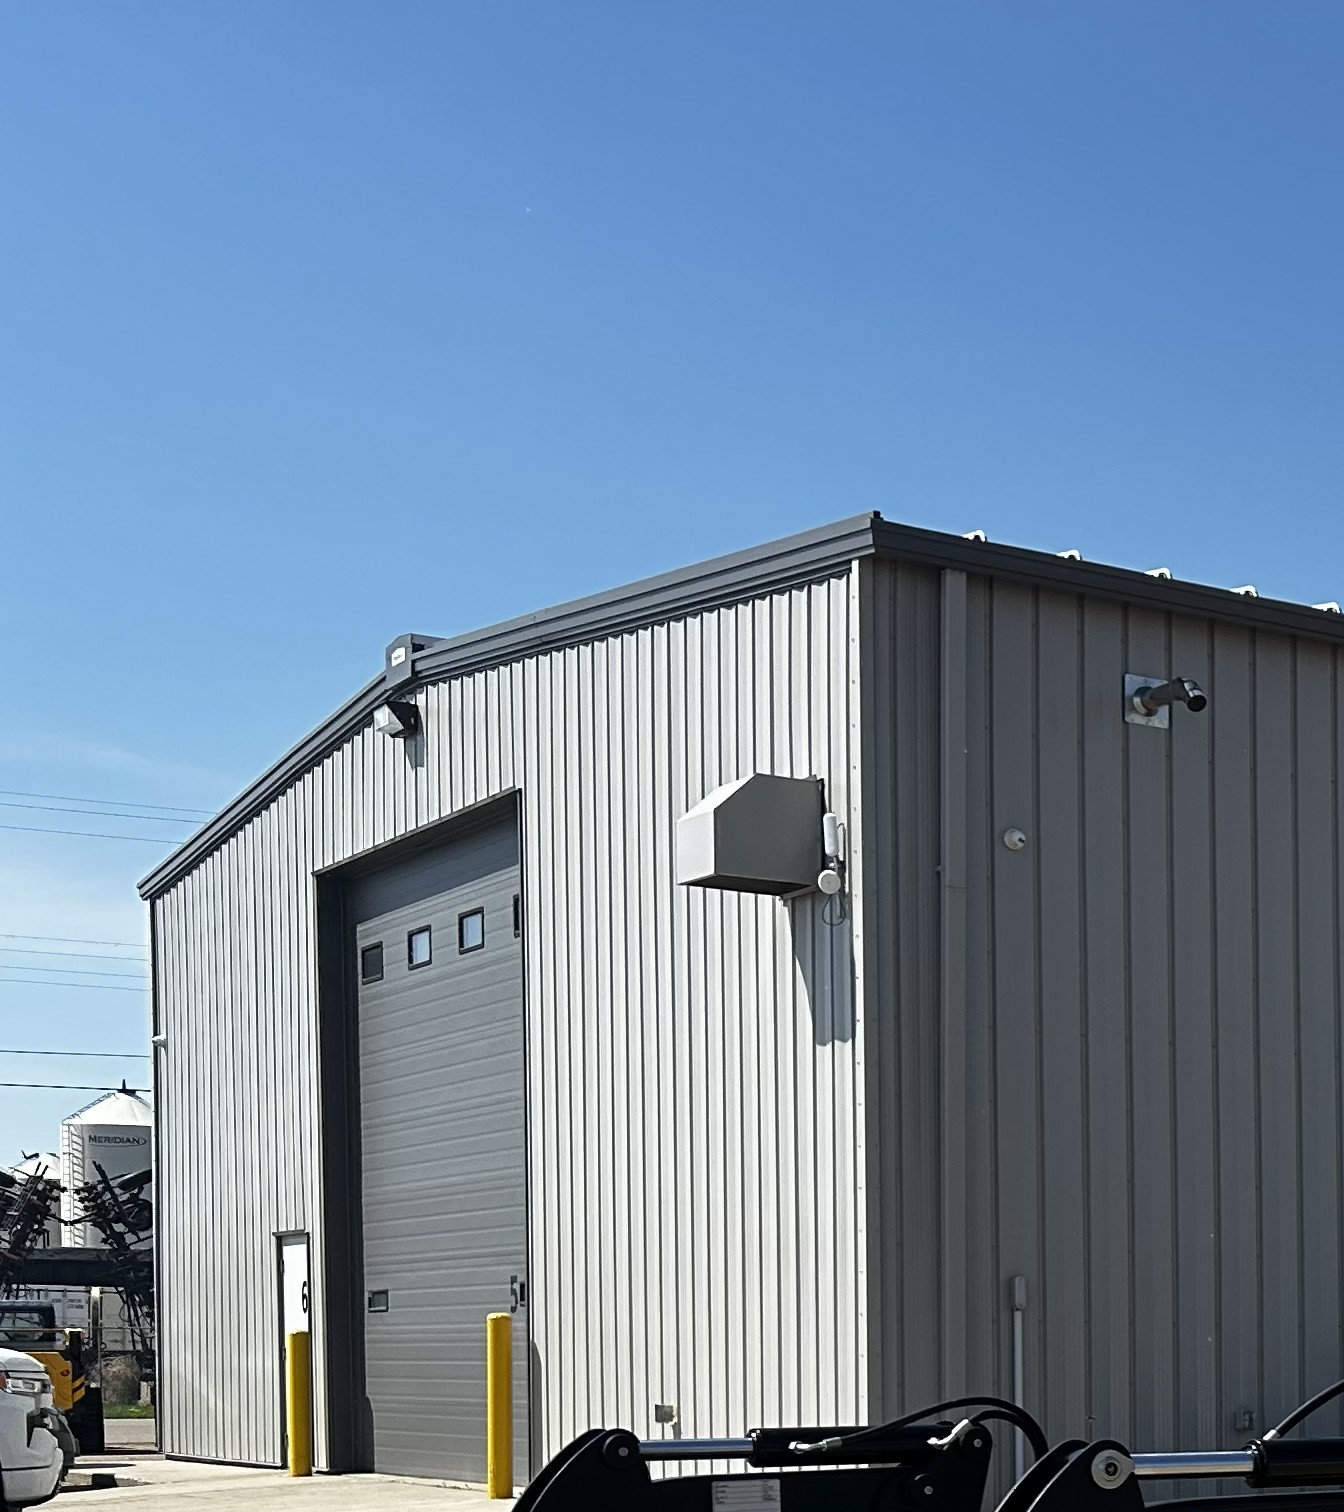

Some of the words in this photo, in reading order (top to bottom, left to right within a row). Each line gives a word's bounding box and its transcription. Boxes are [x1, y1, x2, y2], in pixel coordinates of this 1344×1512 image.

[88, 1134, 141, 1144] MERIDIAN
[302, 1281, 308, 1313] 6
[511, 1275, 519, 1312] 5
